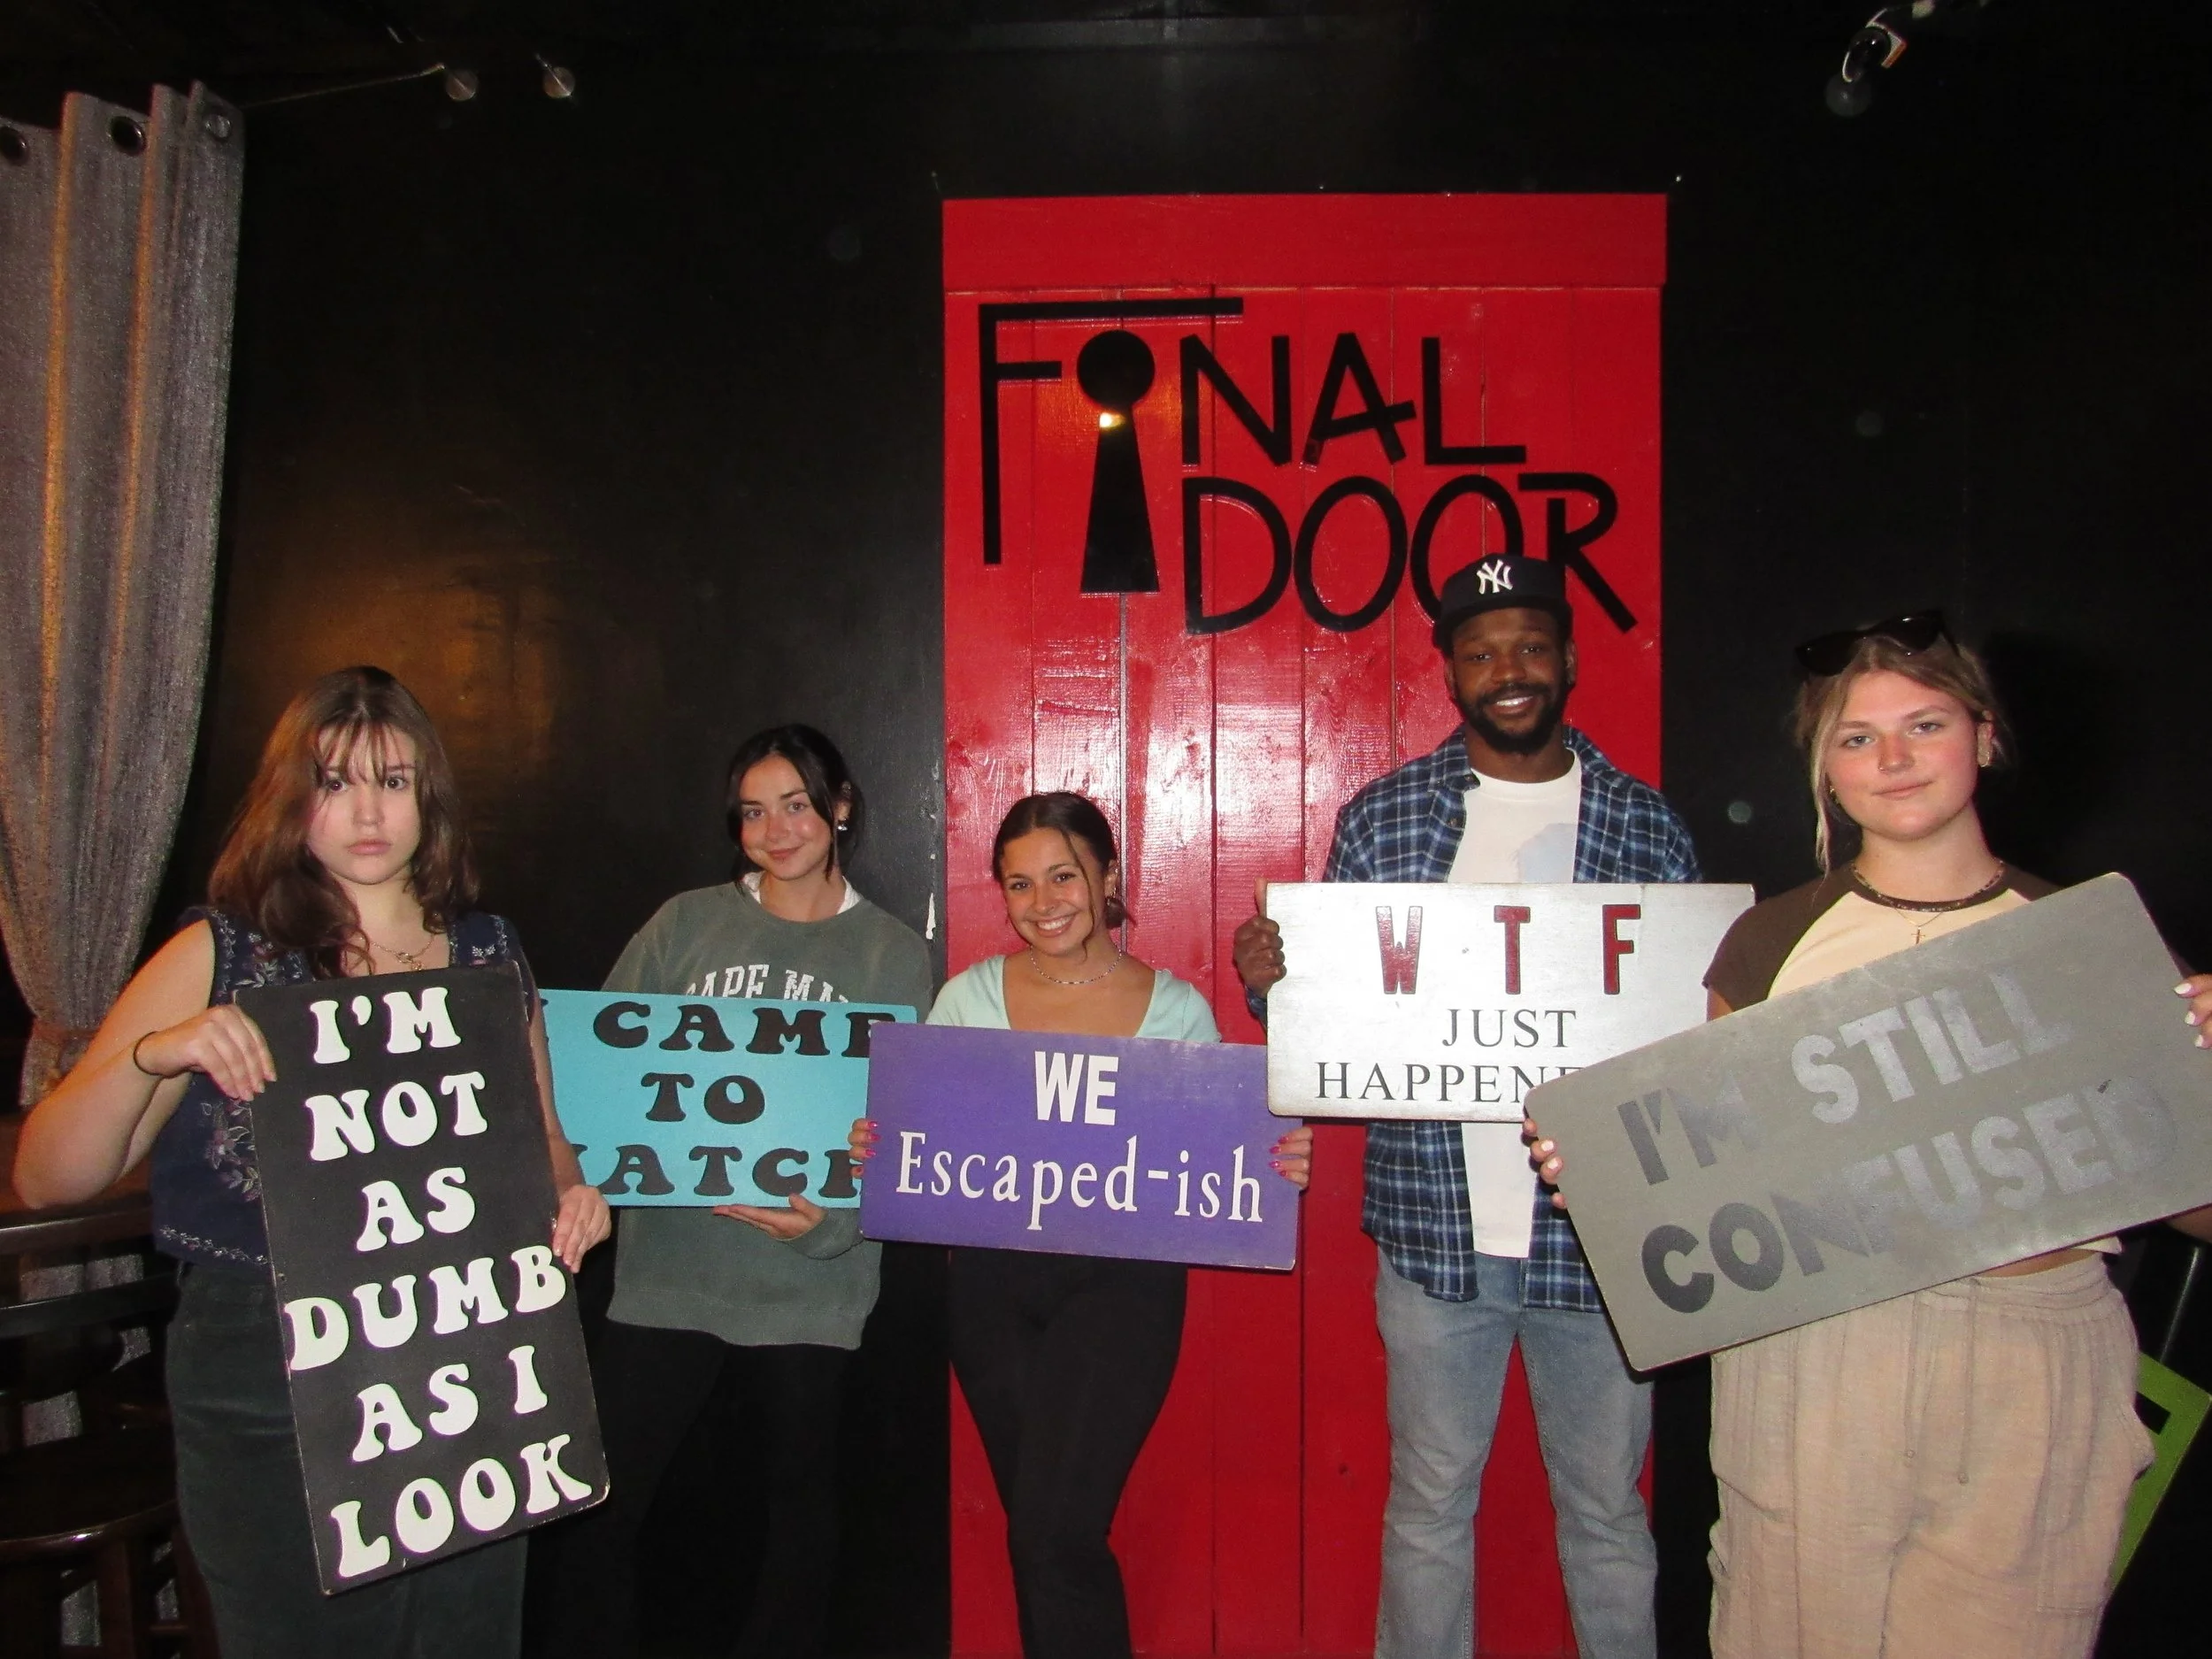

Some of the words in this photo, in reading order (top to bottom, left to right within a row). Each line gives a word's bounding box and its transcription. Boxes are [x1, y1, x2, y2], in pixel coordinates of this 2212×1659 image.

[978, 297, 1527, 594] FINAL
[1180, 472, 1639, 636] DOOR
[1476, 559, 1511, 595] NY
[310, 987, 462, 1064] I'M
[1442, 1009, 1577, 1048] JUST
[305, 1071, 488, 1162] NOT
[641, 1072, 765, 1125] TO
[1034, 1050, 1119, 1125] WE
[1316, 1062, 1585, 1103] HAPPEN
[1617, 1072, 1761, 1186] I'M
[1791, 971, 2071, 1125] STILL
[356, 1167, 476, 1252] AS
[571, 1143, 863, 1199] ATC
[895, 1131, 1263, 1232] Escaped-ish
[1641, 1076, 2178, 1315] CONFUSED
[284, 1245, 566, 1371] DUMB
[353, 1363, 480, 1463] AS
[508, 1345, 549, 1414] I
[331, 1433, 592, 1578] LOOK
